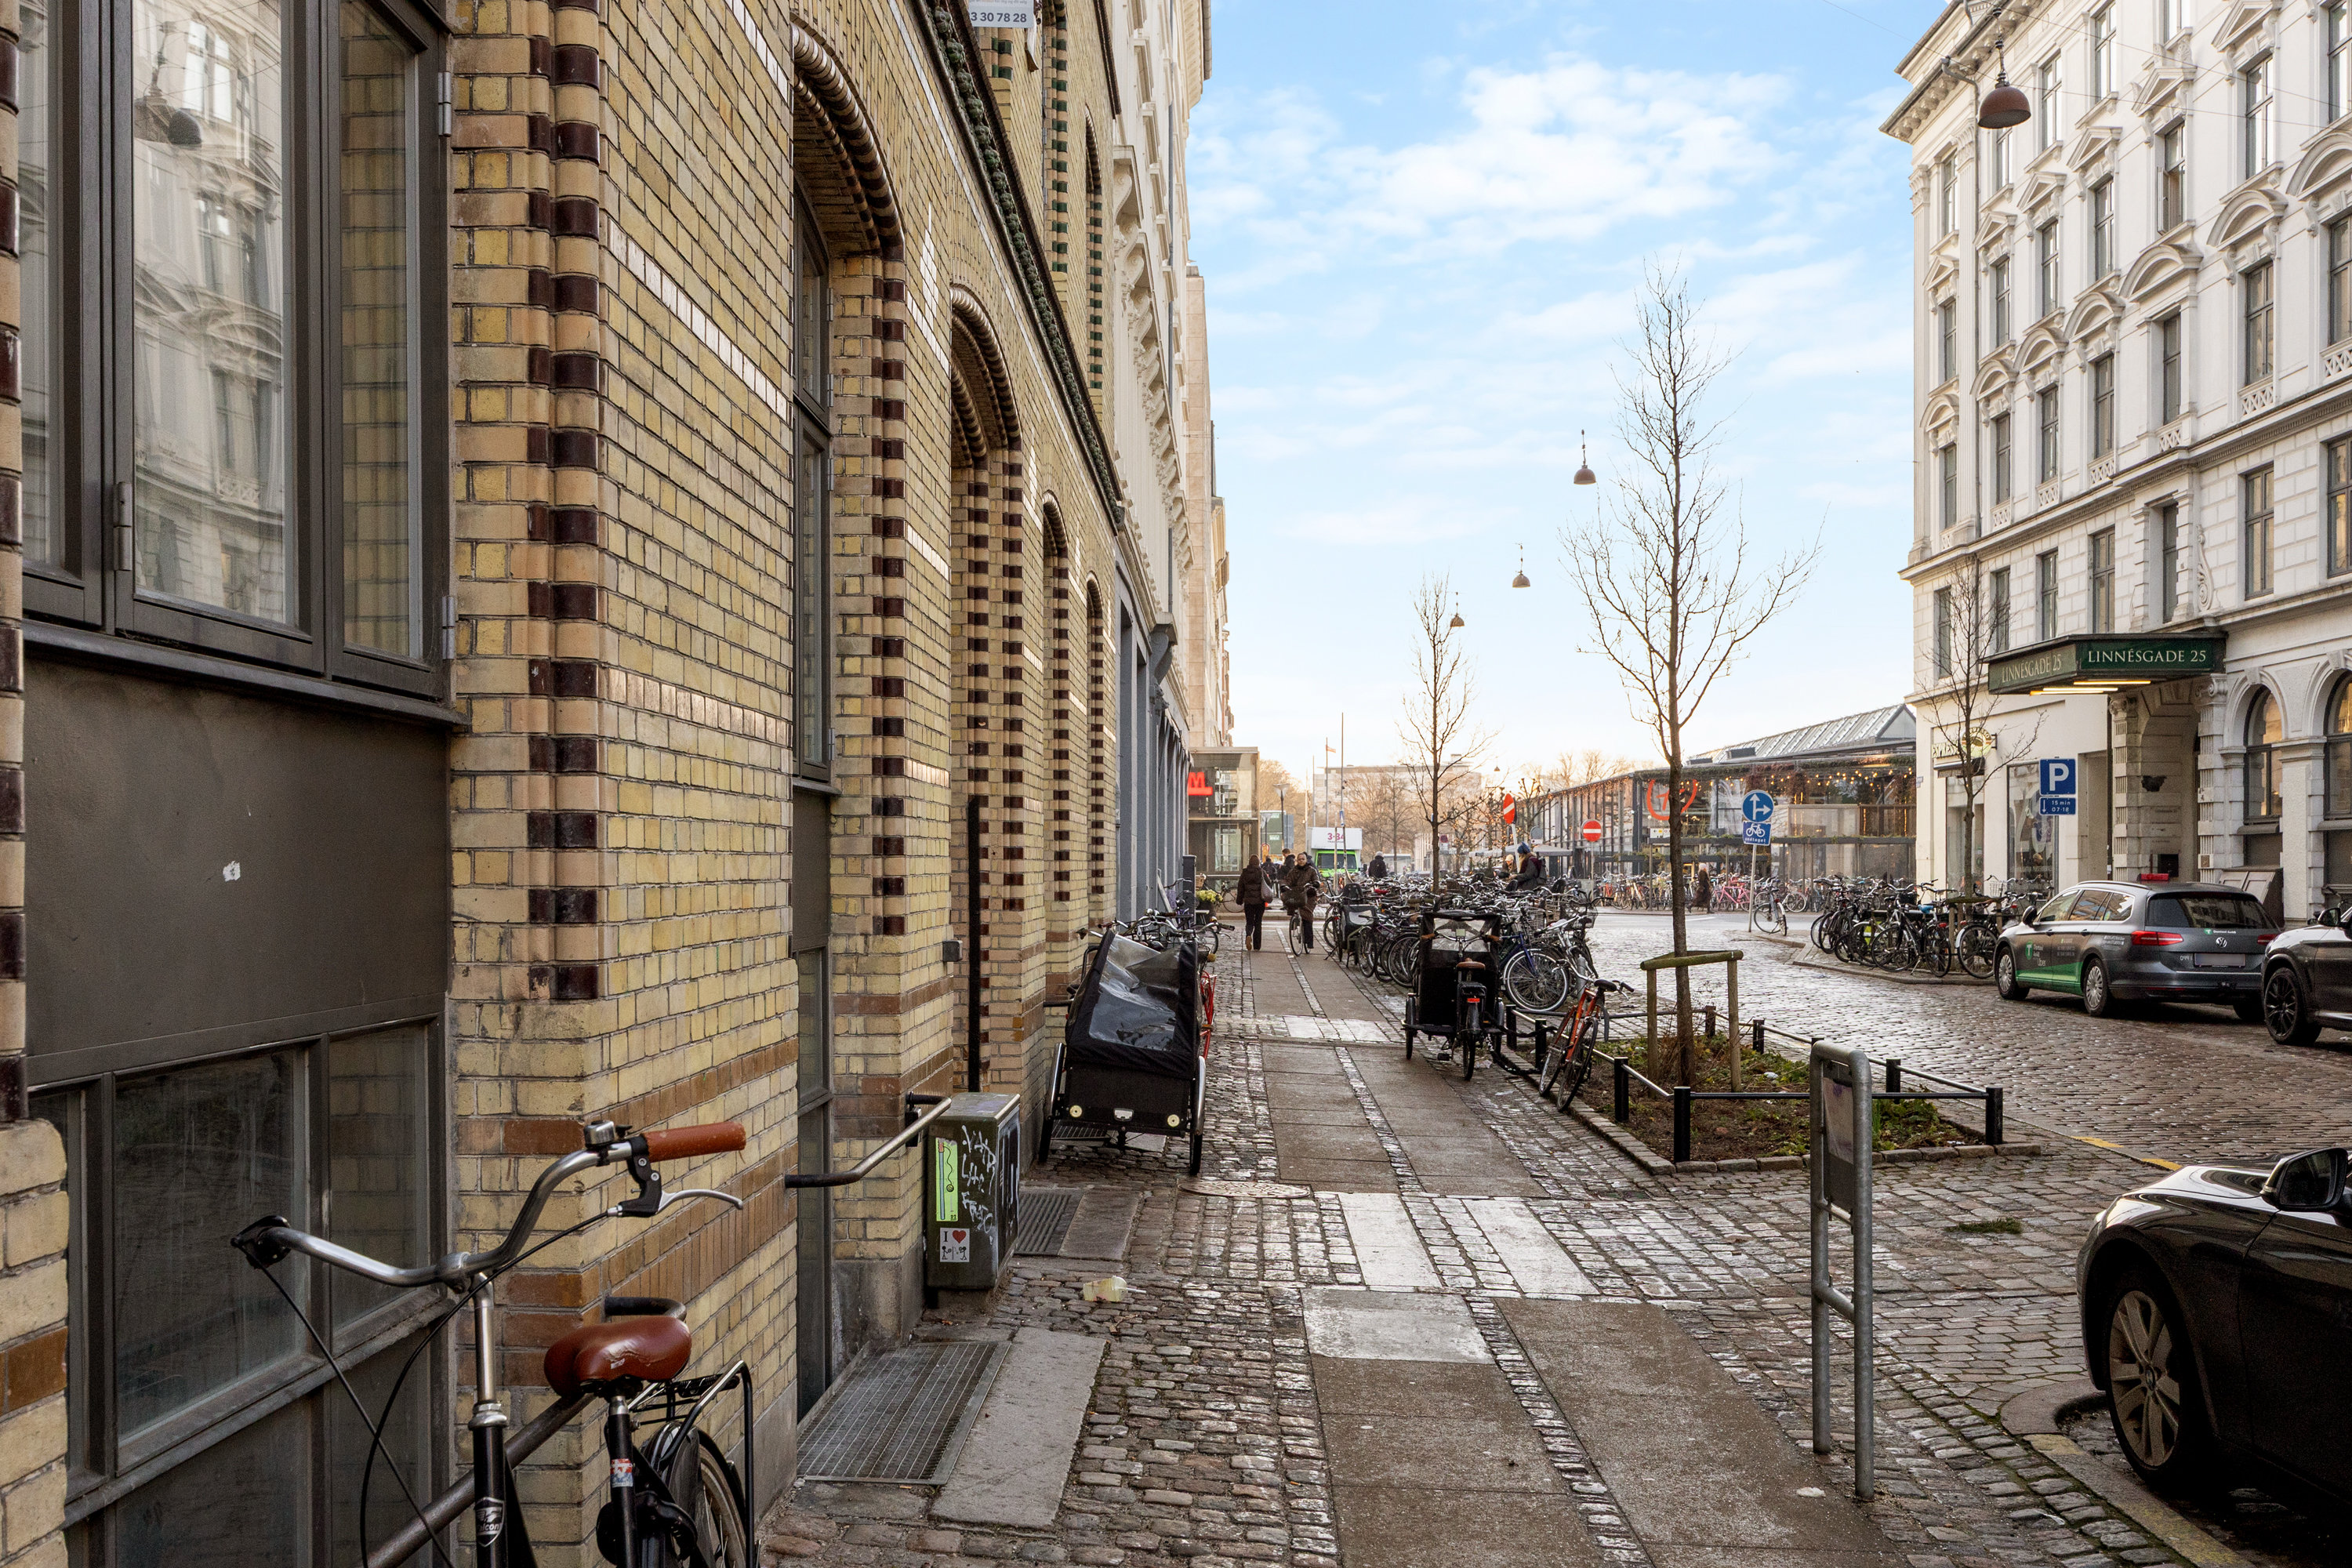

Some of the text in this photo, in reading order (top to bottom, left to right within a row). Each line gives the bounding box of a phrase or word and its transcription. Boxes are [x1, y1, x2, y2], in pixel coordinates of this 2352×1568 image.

[969, 12, 1027, 23] 3 30 78 28
[2088, 648, 2206, 662] LINNÉSGADE 25
[2002, 654, 2061, 683] LINNÉSGADE 25
[2049, 763, 2070, 791] P
